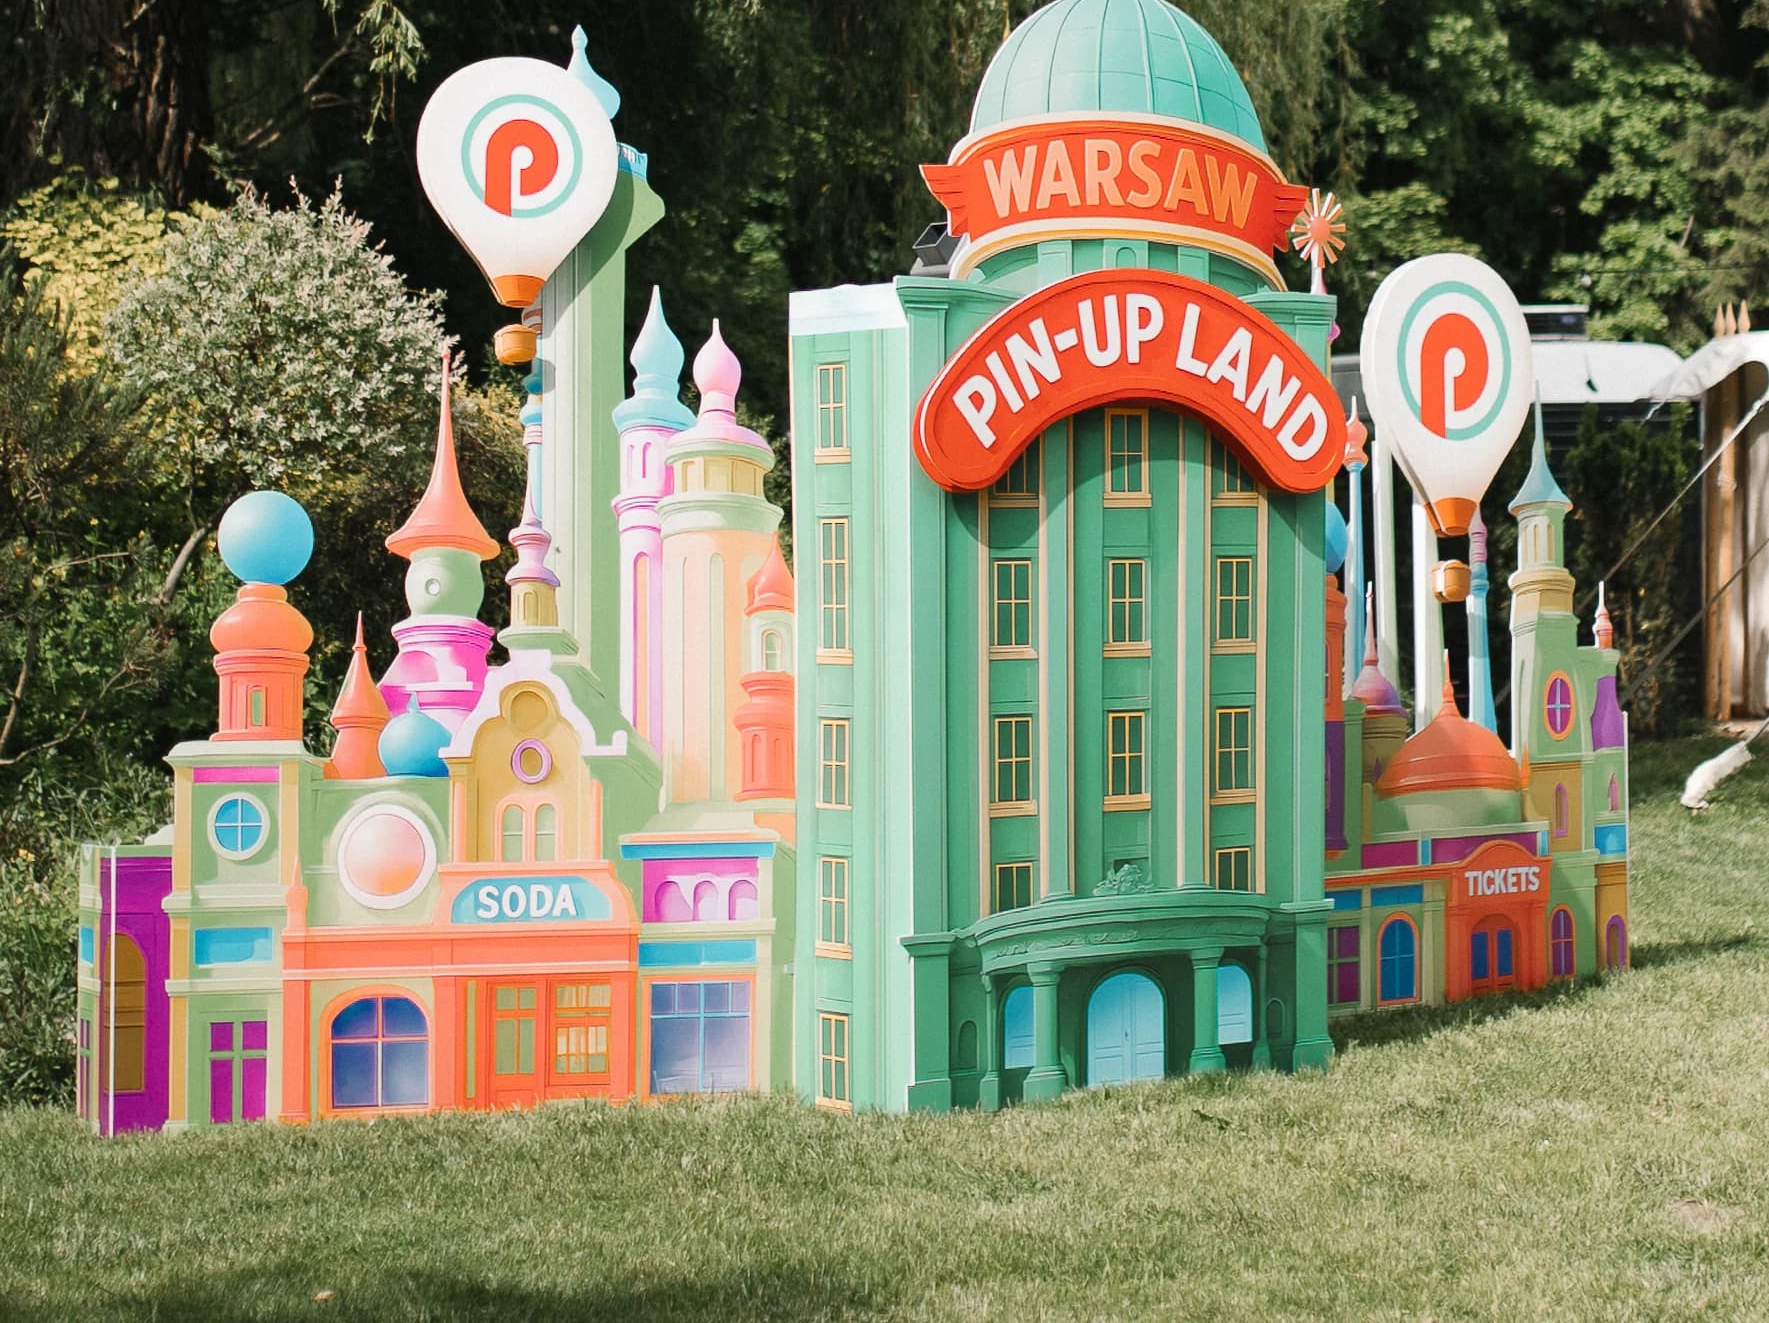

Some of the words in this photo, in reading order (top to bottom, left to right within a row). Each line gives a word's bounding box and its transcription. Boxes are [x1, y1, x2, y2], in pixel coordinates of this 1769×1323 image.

[983, 139, 1257, 230] WARSAW
[952, 293, 1164, 448] PIN-UP
[1175, 302, 1328, 461] LAND
[476, 884, 577, 919] SODA
[1464, 866, 1540, 896] TICKETS
